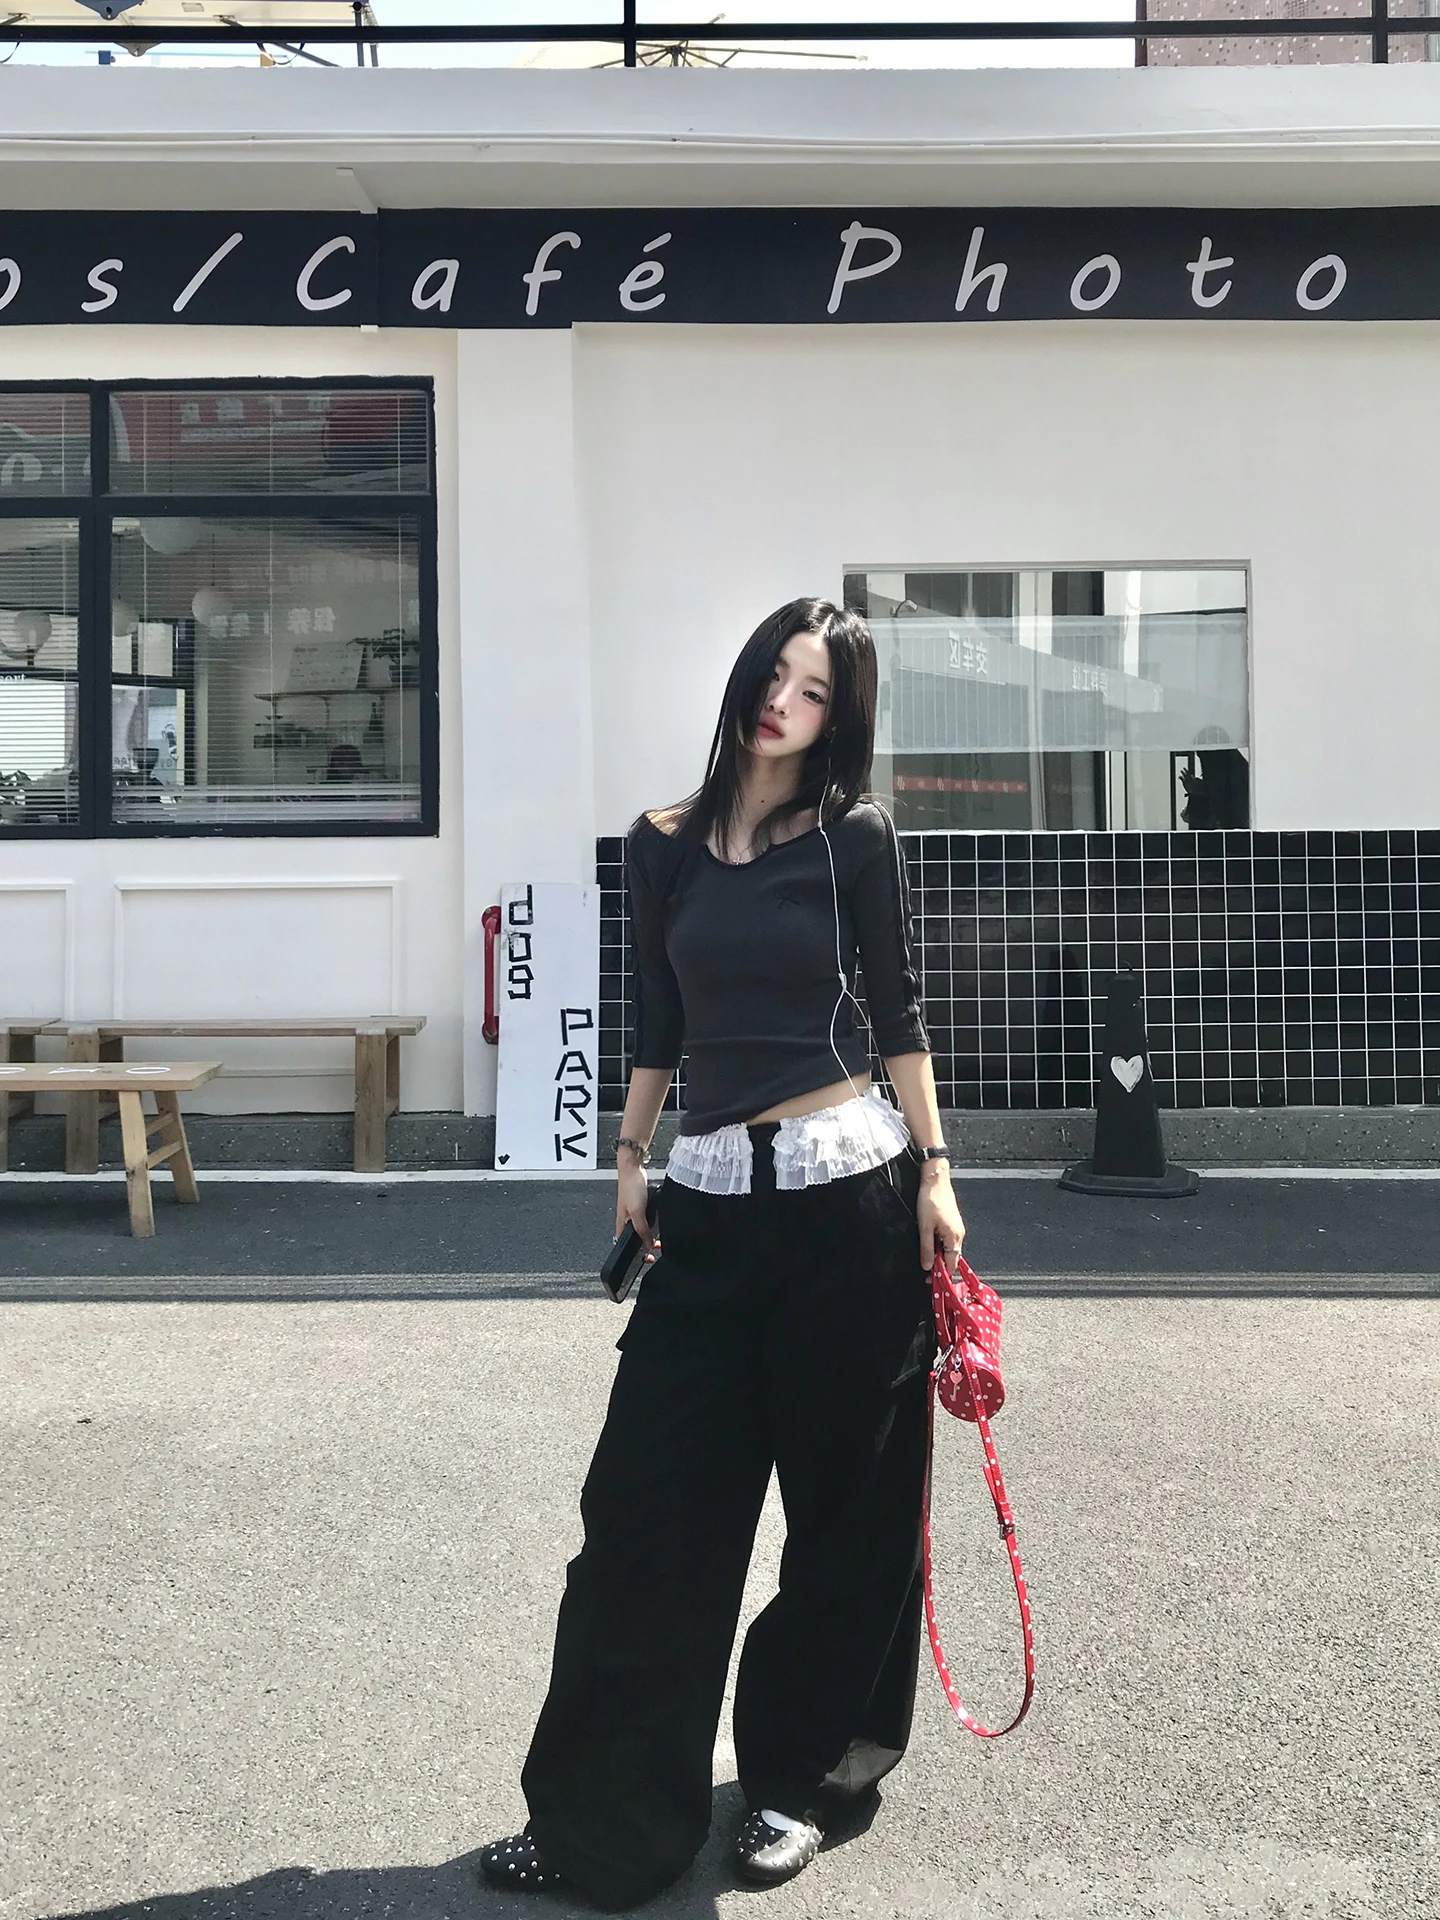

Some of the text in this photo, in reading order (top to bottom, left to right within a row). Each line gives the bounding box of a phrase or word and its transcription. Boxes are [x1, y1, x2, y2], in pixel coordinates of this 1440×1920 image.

[826, 220, 1348, 314] Photo
[508, 884, 534, 1000] dog
[554, 1007, 594, 1162] PARK
